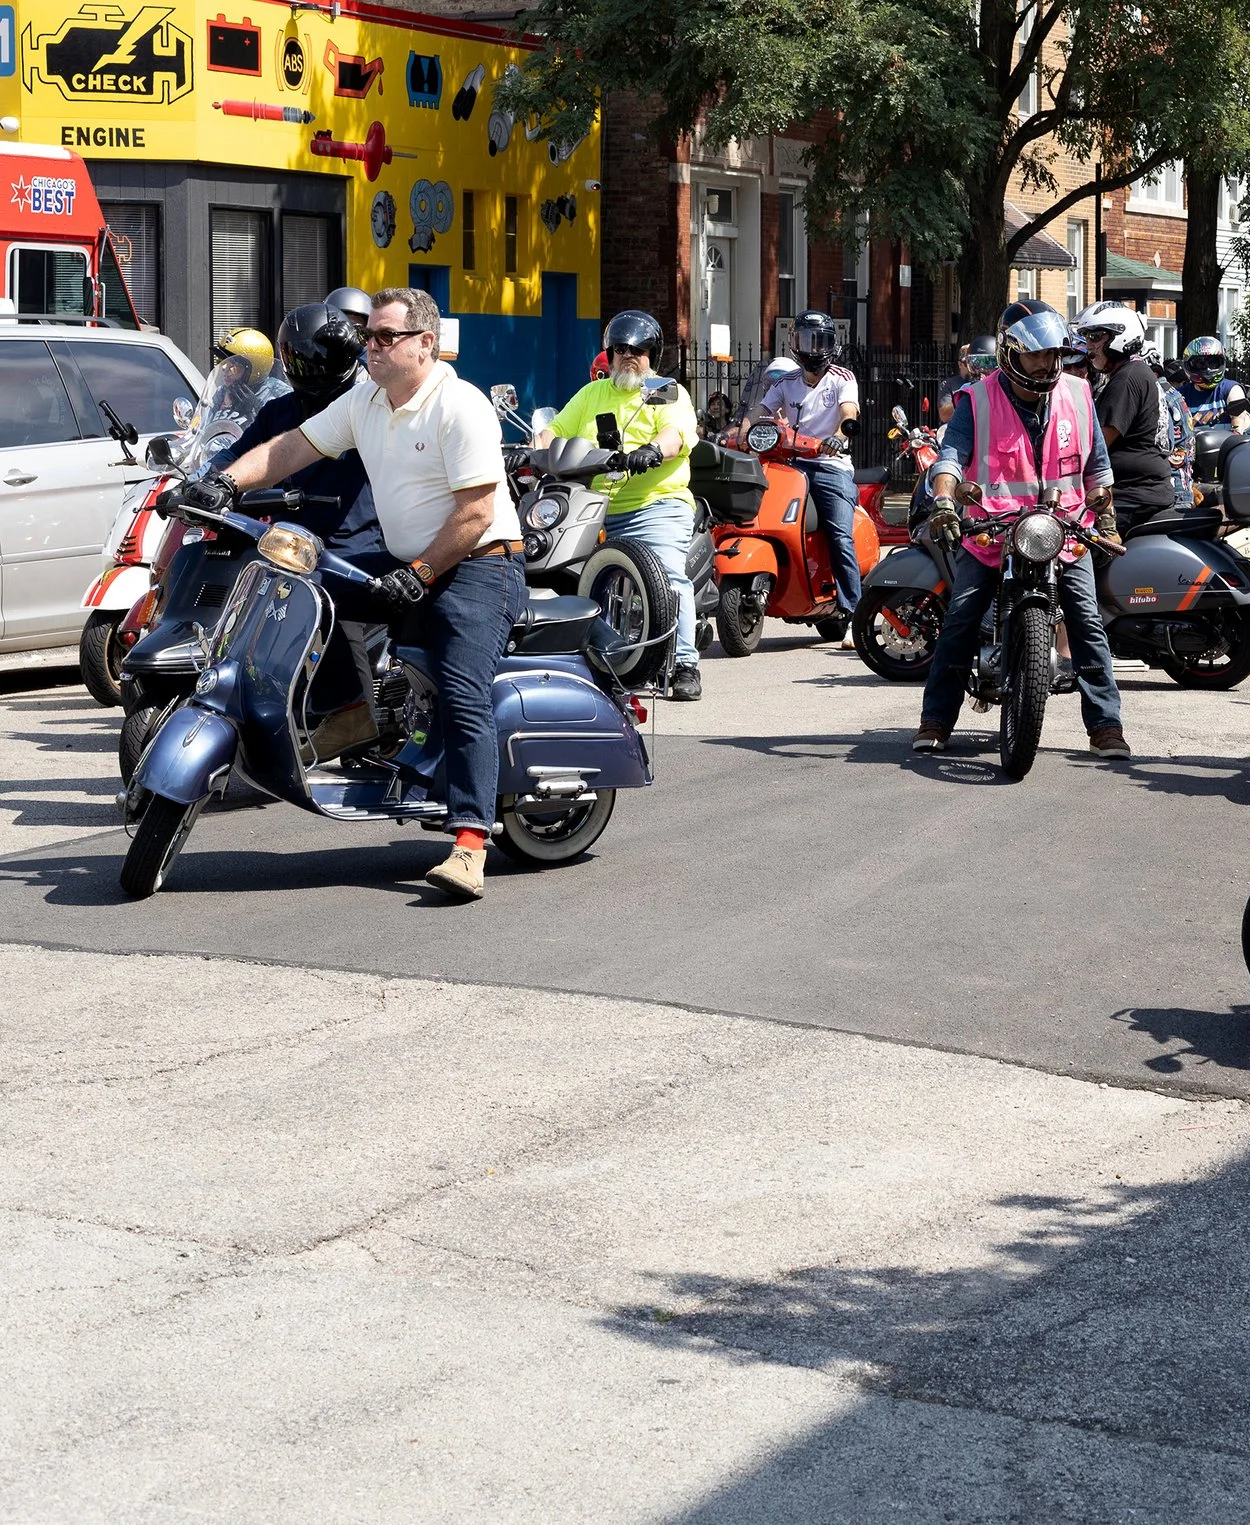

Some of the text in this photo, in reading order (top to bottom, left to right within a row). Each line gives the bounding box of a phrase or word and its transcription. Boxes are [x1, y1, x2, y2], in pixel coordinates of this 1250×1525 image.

[284, 54, 303, 72] ABS
[72, 74, 147, 92] CHECK
[61, 127, 146, 148] ENGINE
[32, 177, 76, 190] CHICAGO'S
[32, 189, 75, 215] BEST
